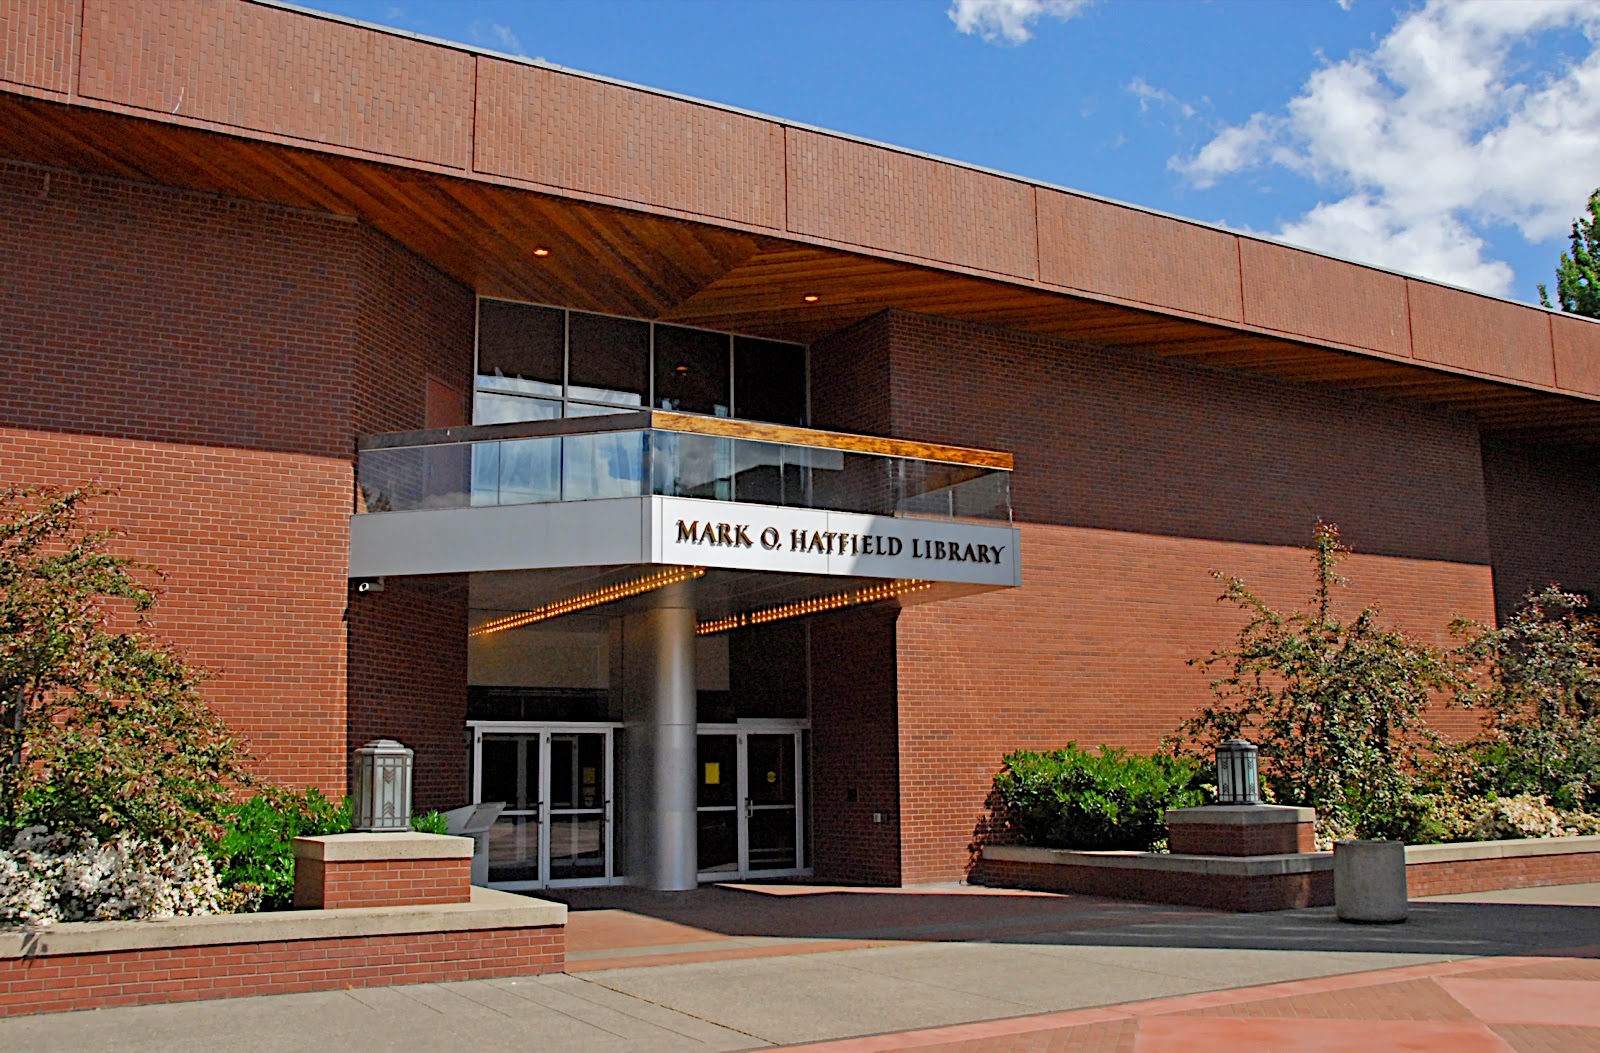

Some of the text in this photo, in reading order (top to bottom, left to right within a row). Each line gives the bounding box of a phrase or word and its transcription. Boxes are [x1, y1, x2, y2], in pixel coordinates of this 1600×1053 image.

[677, 519, 1005, 564] MARK O. HATFIELD LIBRARY
